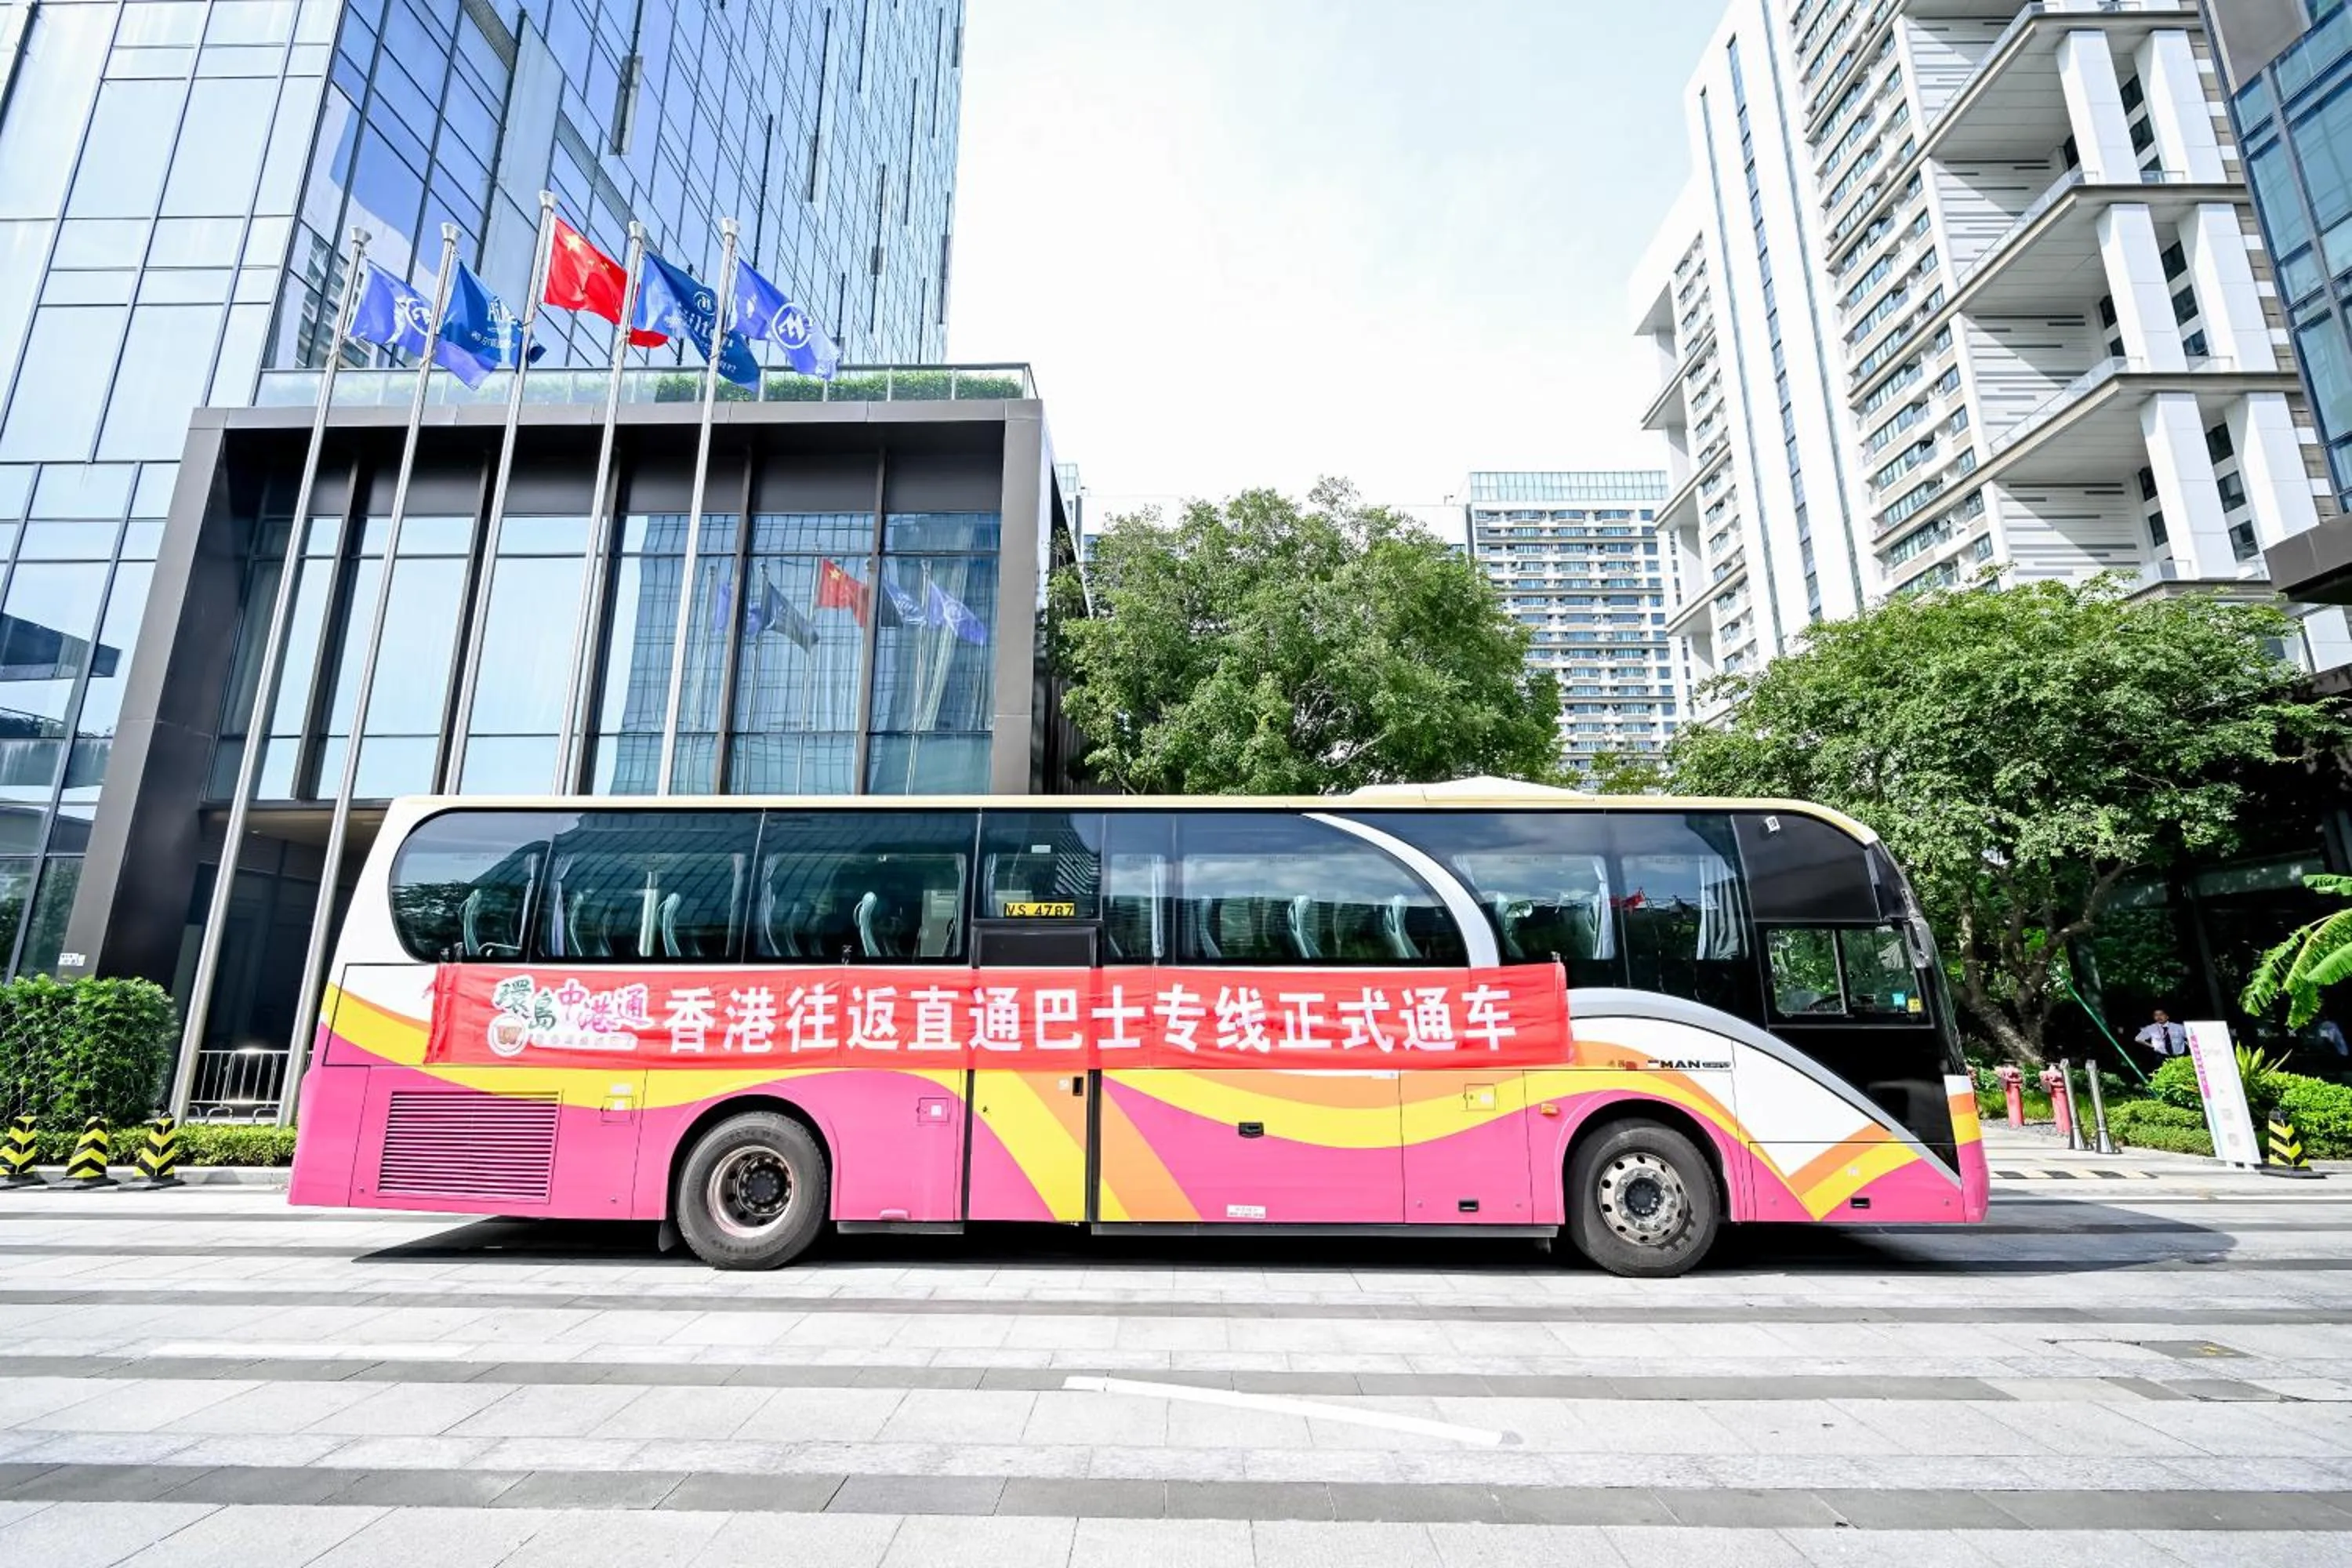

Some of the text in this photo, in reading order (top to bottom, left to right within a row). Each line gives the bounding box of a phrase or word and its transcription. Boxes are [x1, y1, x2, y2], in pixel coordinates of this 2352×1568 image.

[1006, 904, 1073, 916] VS 4787
[663, 982, 1517, 1053] 香港往返直通巴士专线正式通车
[1660, 1060, 1700, 1069] MAN
